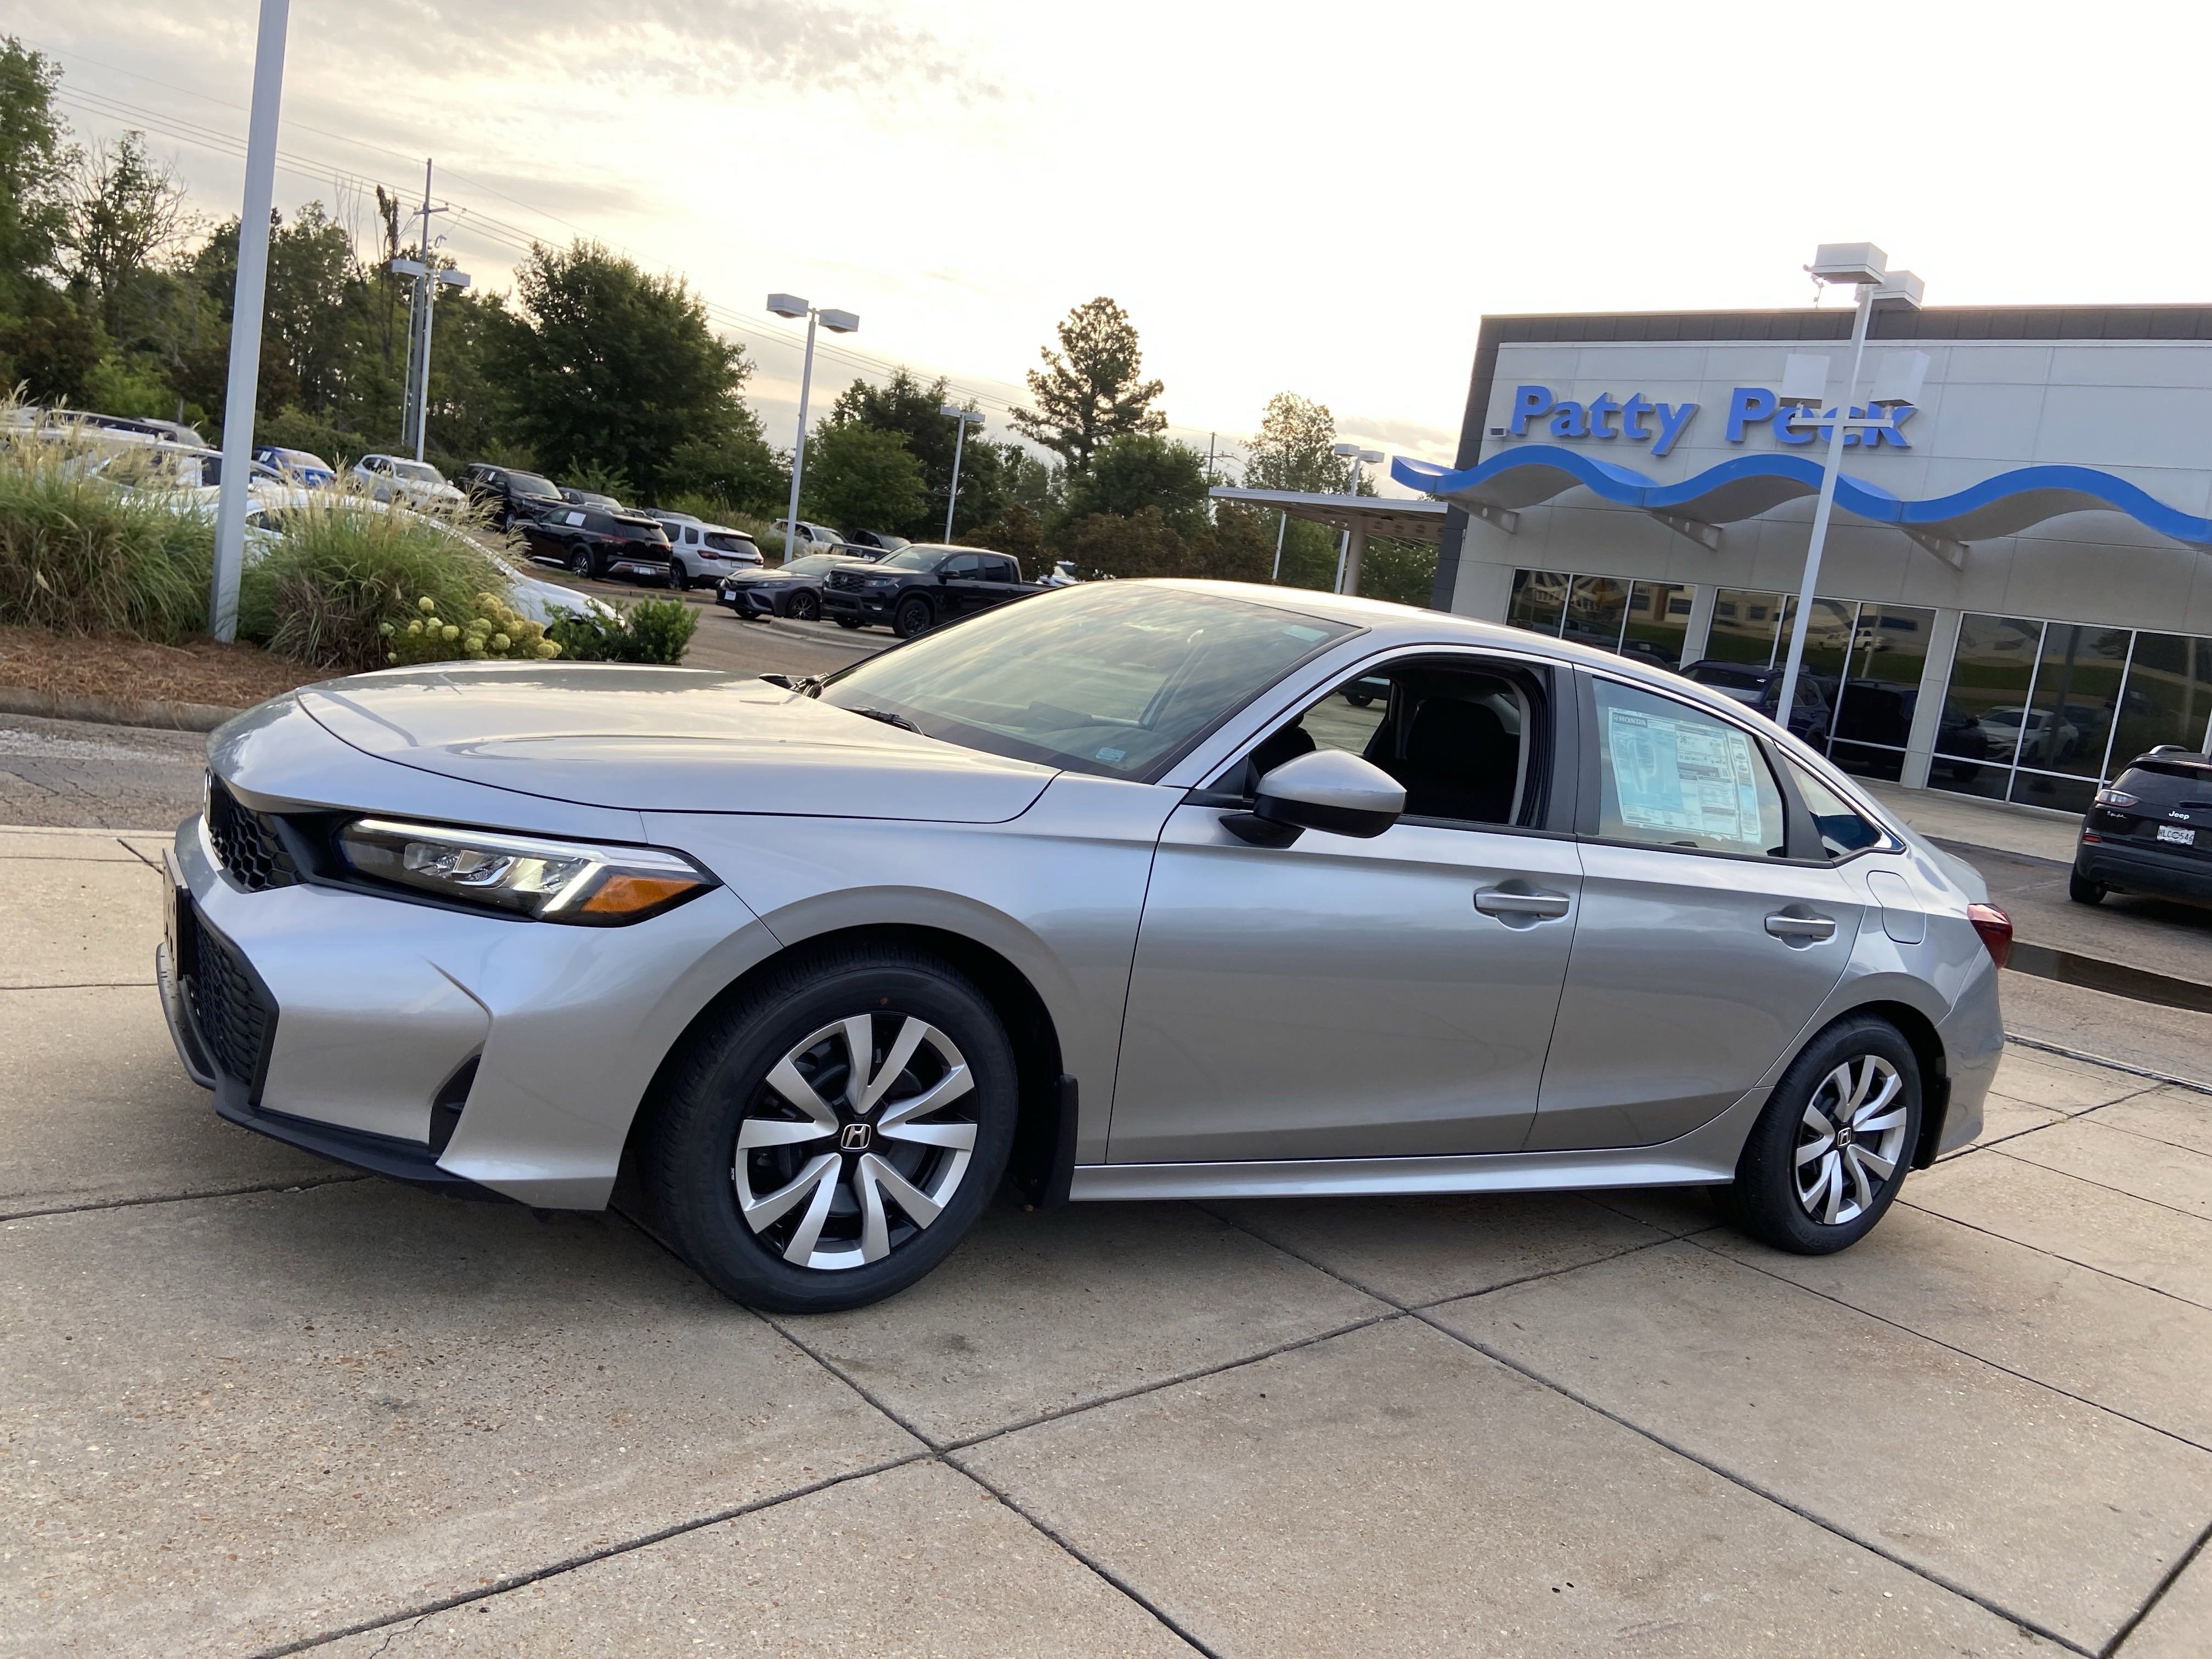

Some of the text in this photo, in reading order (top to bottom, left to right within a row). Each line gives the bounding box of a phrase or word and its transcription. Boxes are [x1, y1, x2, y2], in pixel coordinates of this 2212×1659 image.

[1509, 385, 1700, 456] Patty
[1619, 715, 1646, 726] HONDA
[2168, 811, 2190, 820] Jeep
